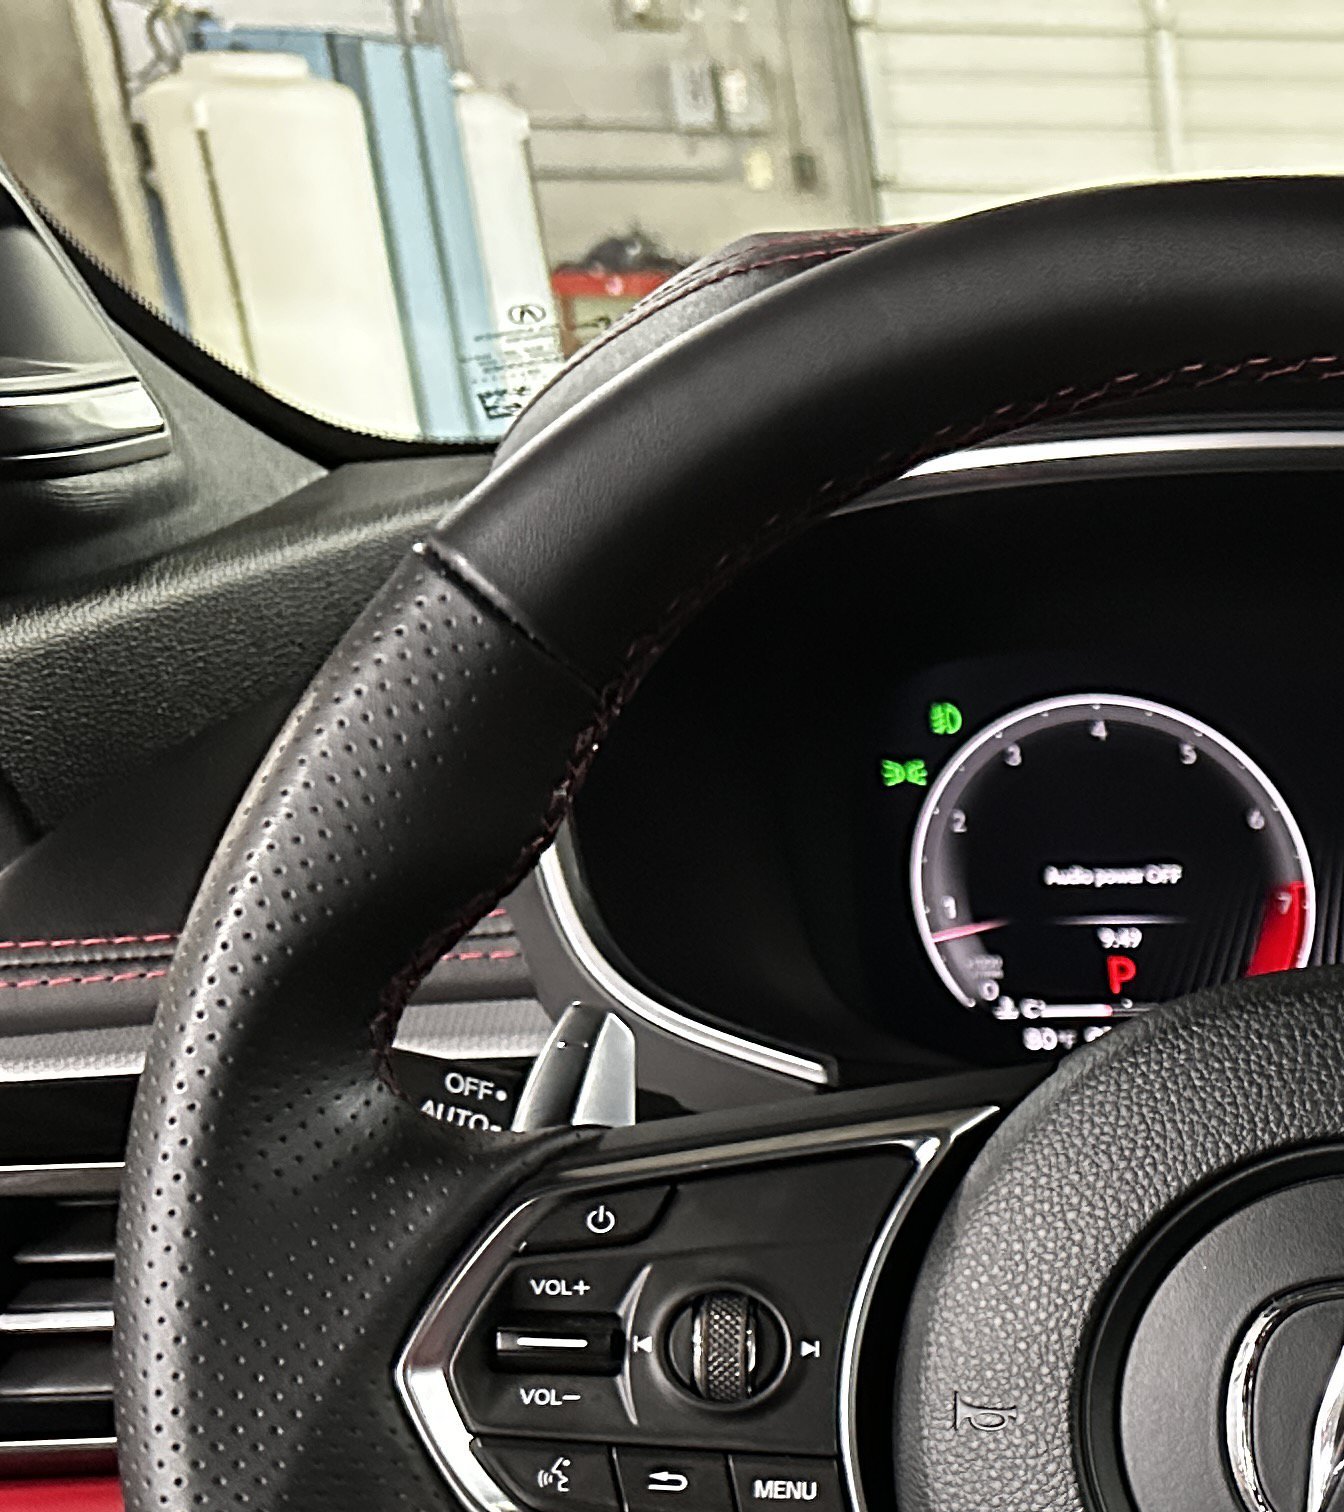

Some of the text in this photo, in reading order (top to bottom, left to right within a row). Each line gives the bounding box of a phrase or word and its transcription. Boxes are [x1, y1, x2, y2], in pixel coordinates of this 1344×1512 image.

[1090, 720, 1107, 741] 4
[1005, 743, 1023, 767] 3
[1179, 742, 1198, 765] 5
[951, 808, 968, 834] 2
[1247, 807, 1267, 831] 6
[1278, 891, 1294, 914] 7
[1107, 955, 1137, 994] P
[444, 1072, 495, 1100] OFF
[420, 1099, 490, 1132] AUTO
[753, 1479, 818, 1501] MENU
